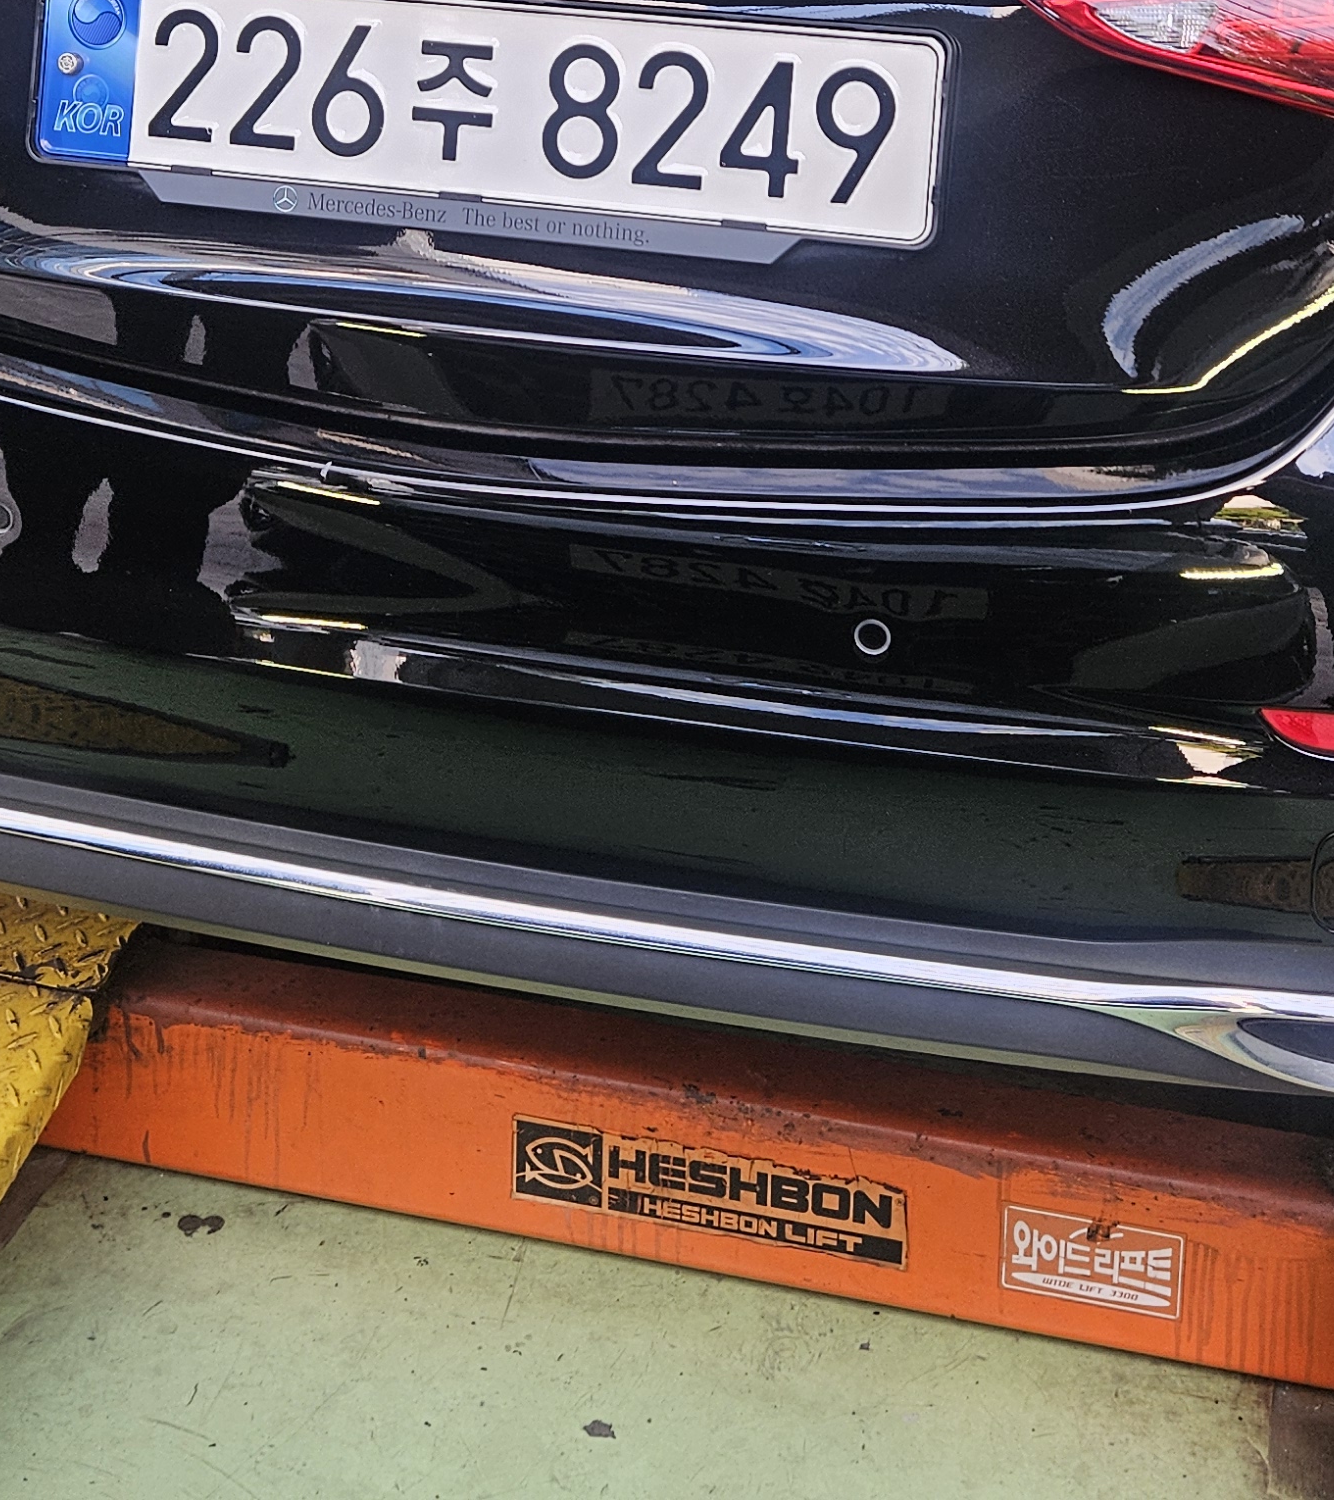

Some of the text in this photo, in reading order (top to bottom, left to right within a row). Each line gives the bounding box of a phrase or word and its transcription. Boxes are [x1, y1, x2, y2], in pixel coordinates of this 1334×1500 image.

[53, 100, 125, 137] KOR
[147, 7, 898, 204] 226주 8249
[307, 192, 650, 247] Mercedes-Benz The best or nothing.
[607, 1141, 893, 1230] HESHBON
[643, 1197, 864, 1253] HESHBON LIFT
[1042, 1276, 1139, 1301] WIDE LIFT 3300
